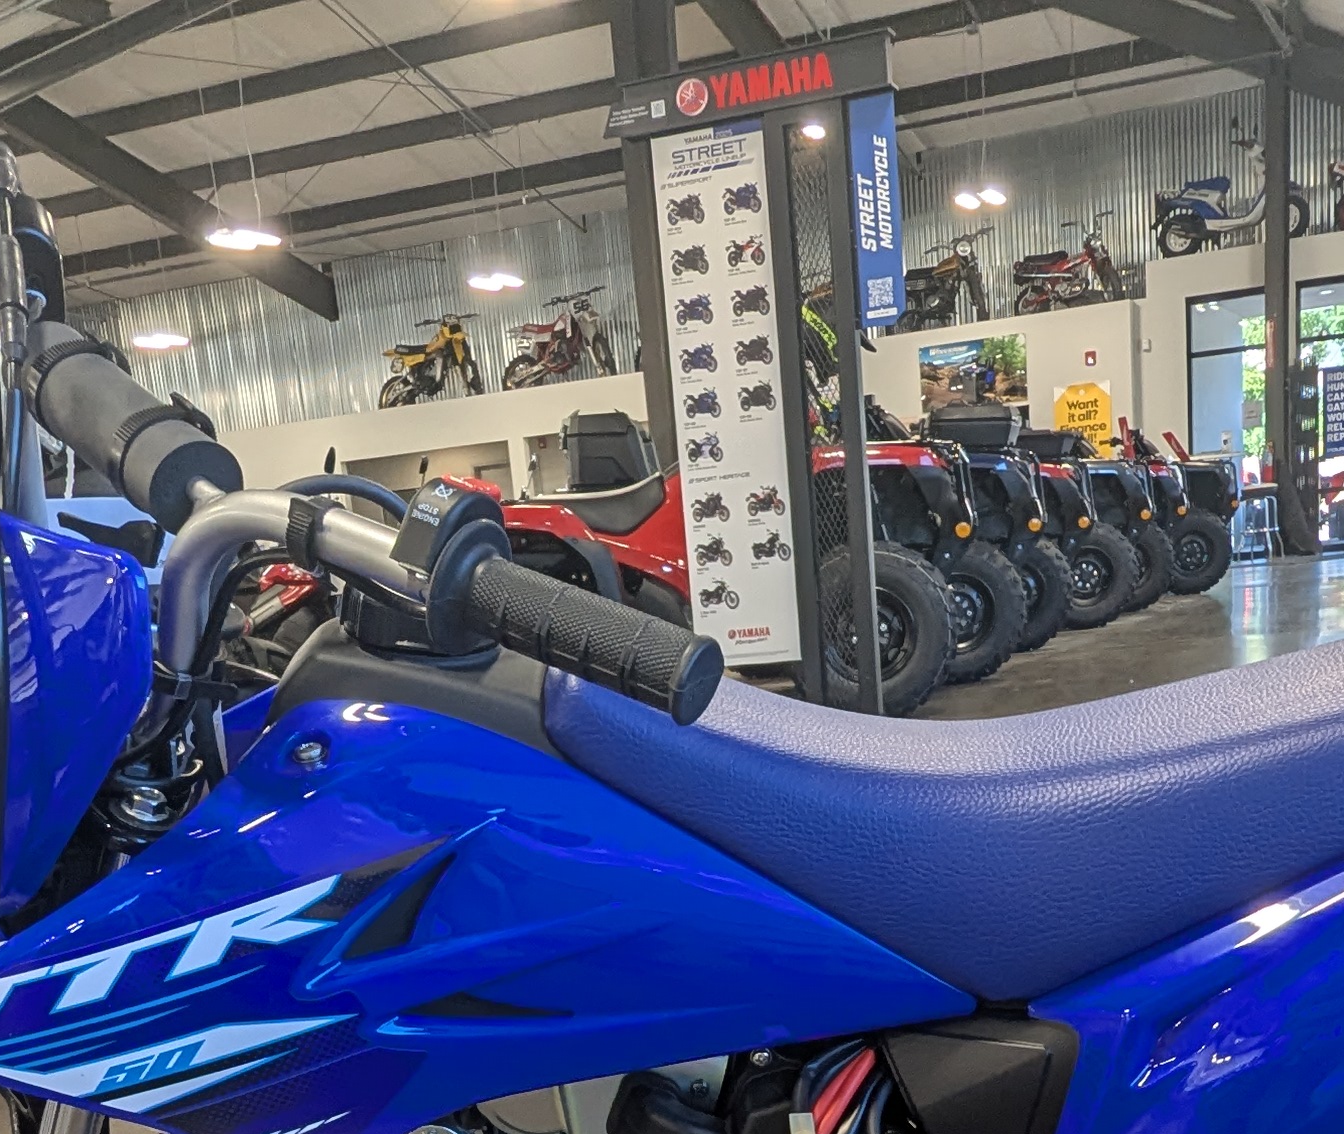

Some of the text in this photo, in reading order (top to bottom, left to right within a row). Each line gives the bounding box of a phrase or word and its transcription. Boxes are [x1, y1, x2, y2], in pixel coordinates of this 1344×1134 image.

[709, 53, 833, 109] YAMAHA
[672, 138, 747, 164] STREET
[878, 135, 894, 250] MOTORCYCLE
[860, 174, 878, 253] STREET
[1066, 398, 1099, 410] Want
[1067, 409, 1099, 423] it all?
[417, 503, 440, 515] STOP
[737, 627, 771, 639] YAMAHA
[94, 1041, 206, 1094] 50
